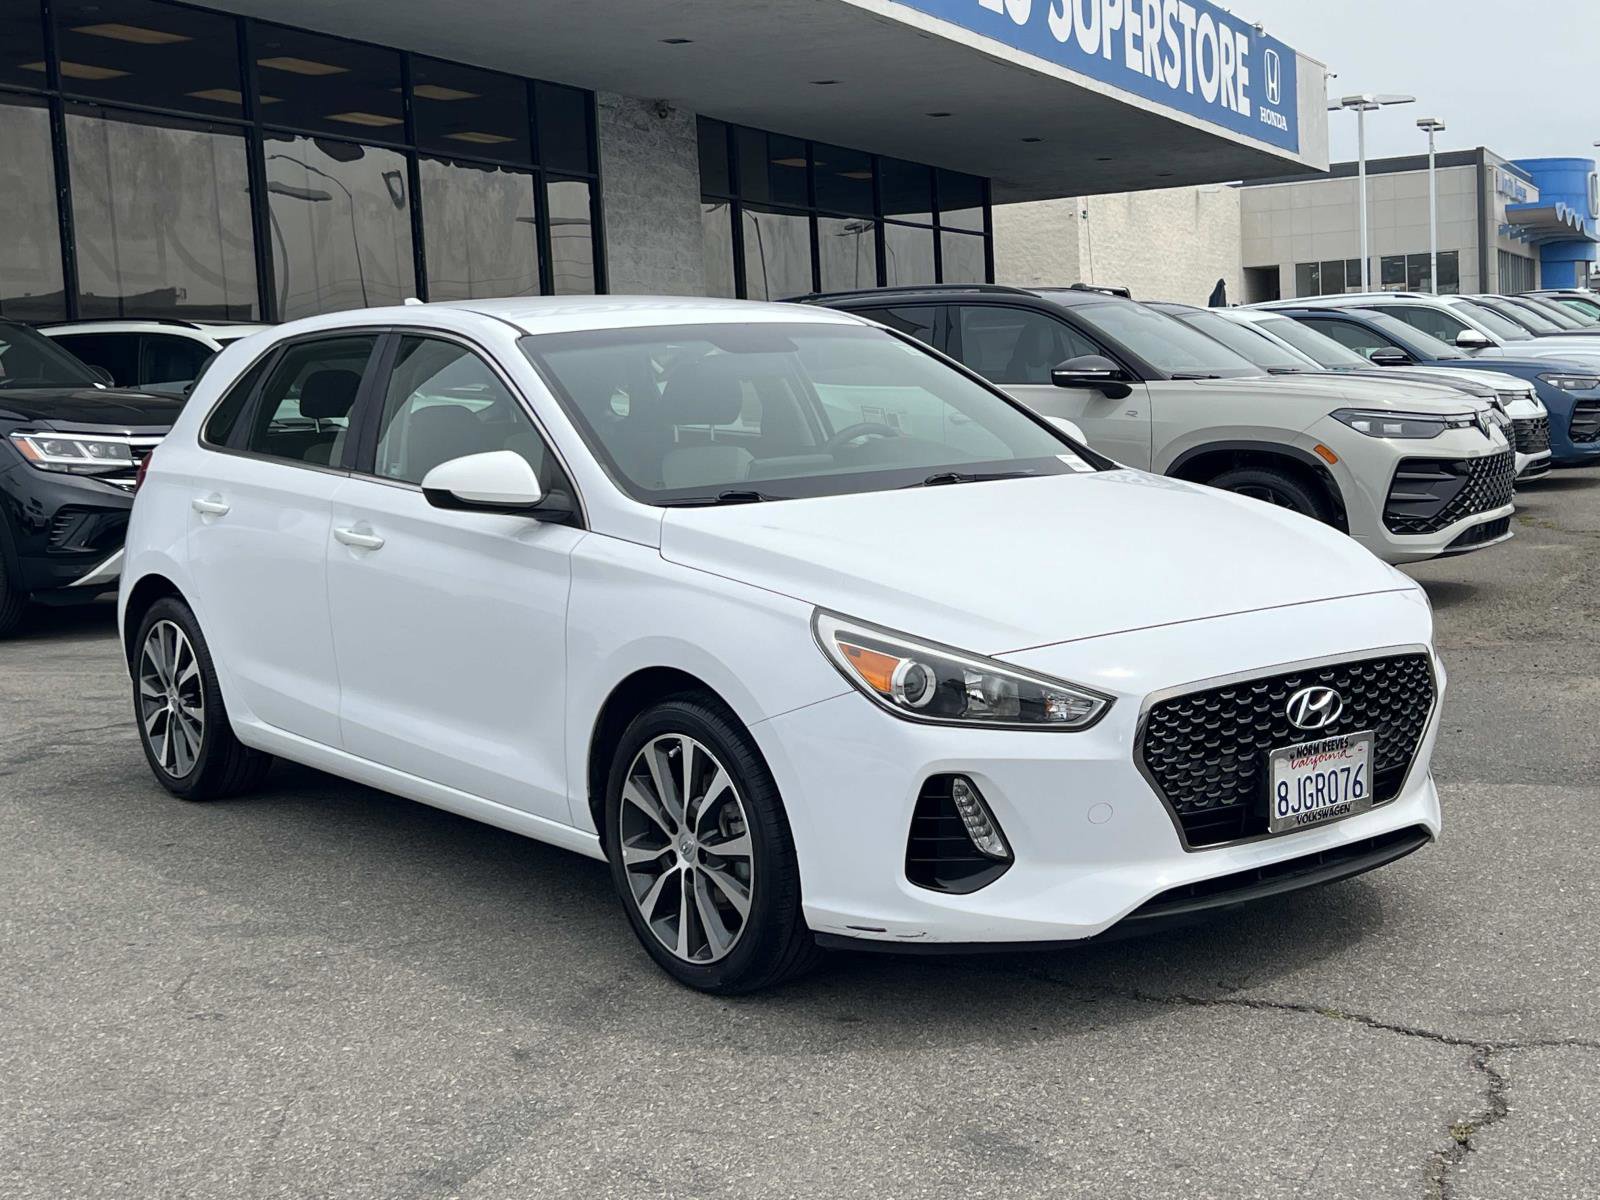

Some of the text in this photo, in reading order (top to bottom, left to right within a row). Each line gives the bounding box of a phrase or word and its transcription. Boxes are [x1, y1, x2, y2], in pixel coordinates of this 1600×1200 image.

[1260, 106, 1288, 131] HONDA
[1296, 738, 1349, 758] NORM REEVES
[1290, 749, 1353, 771] California
[1277, 763, 1364, 816] 8JGR076
[1296, 805, 1351, 825] VOLKSWAGEN
